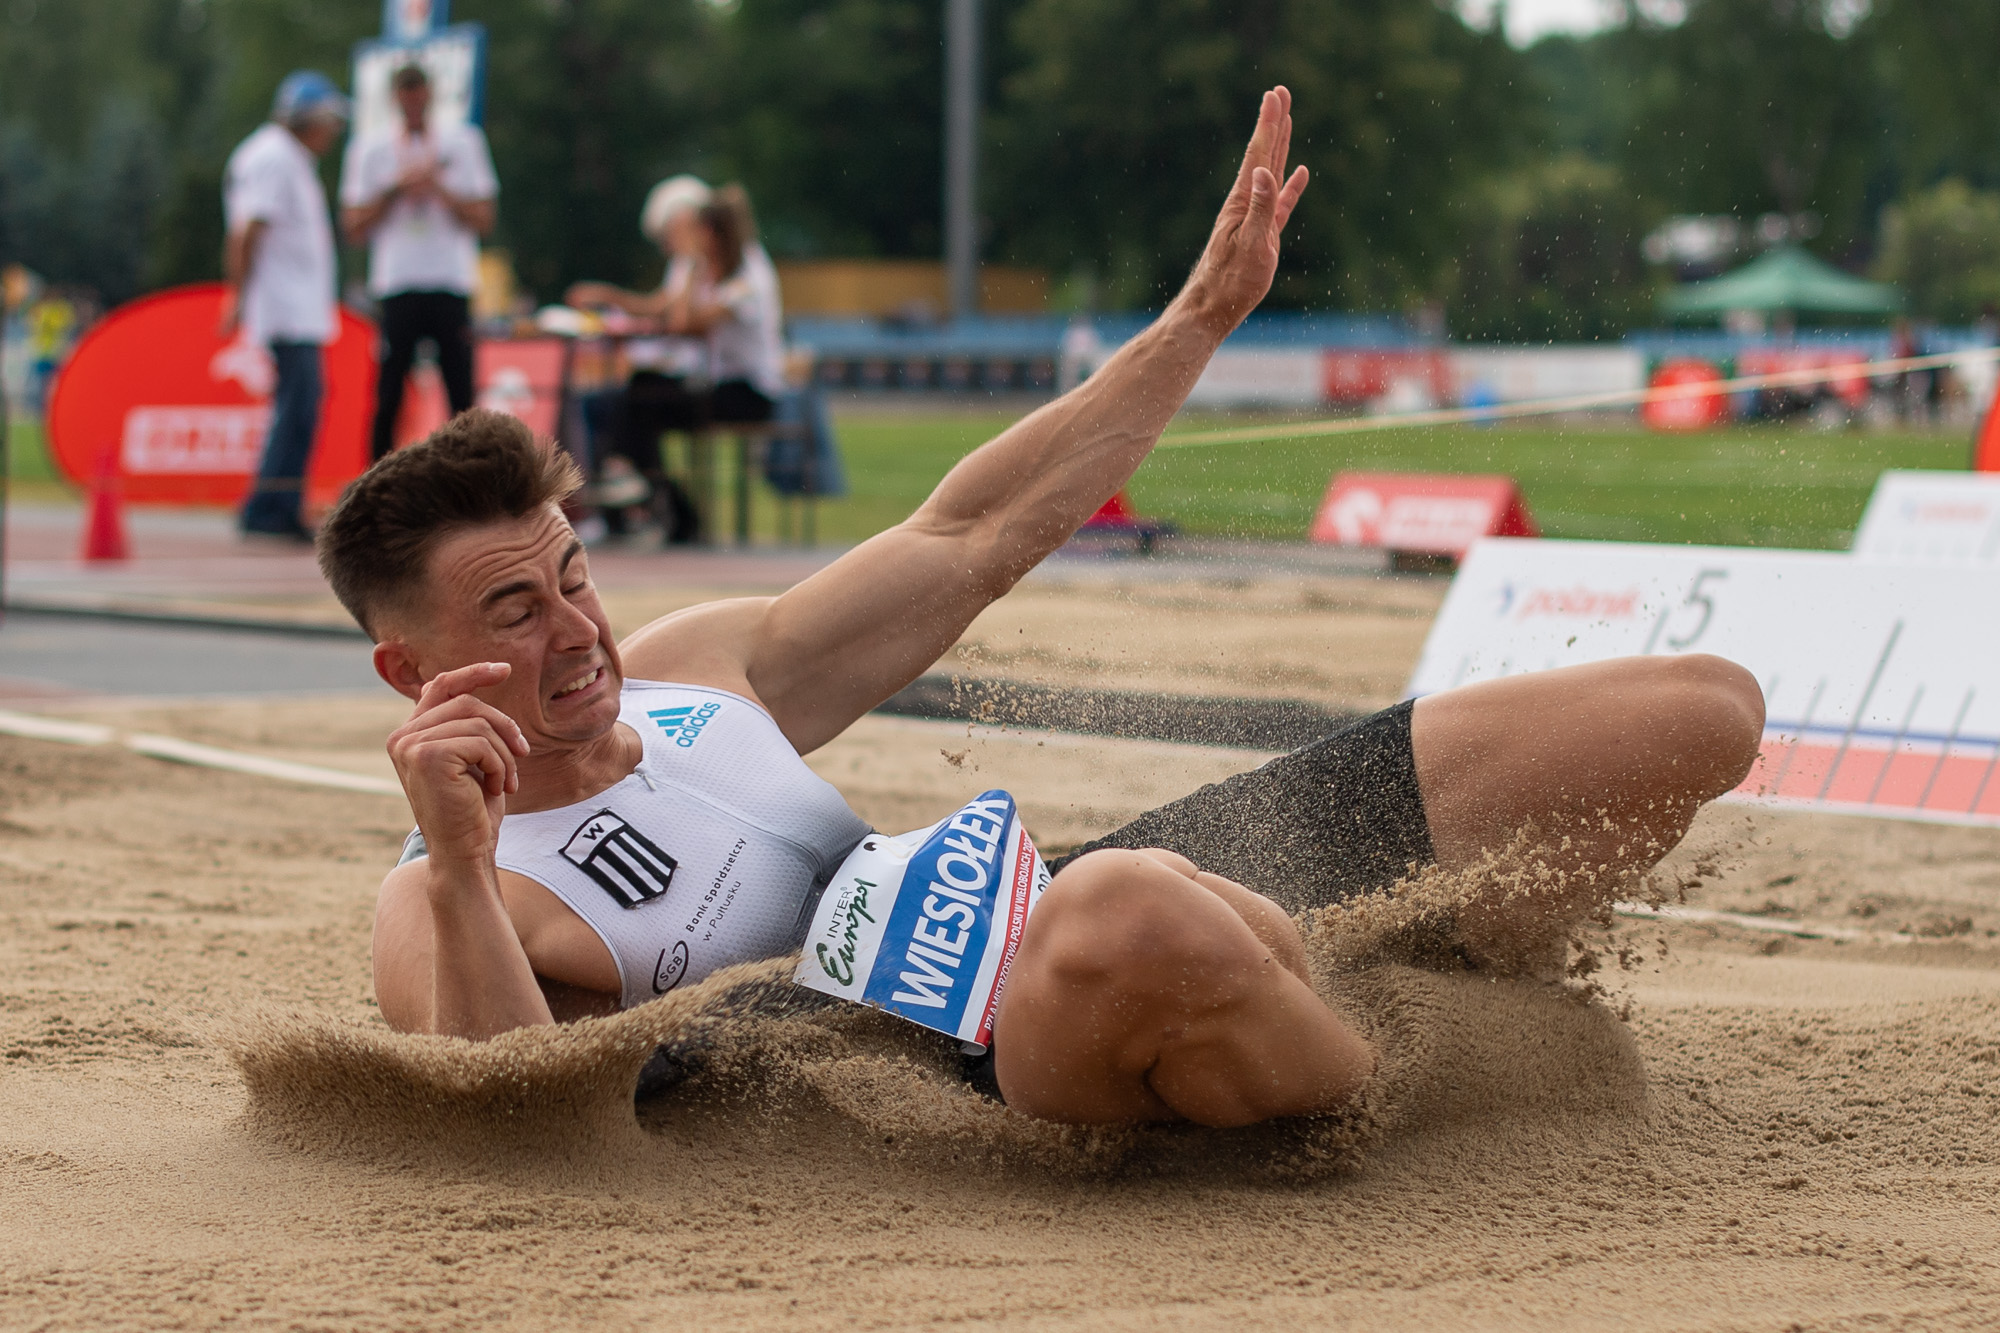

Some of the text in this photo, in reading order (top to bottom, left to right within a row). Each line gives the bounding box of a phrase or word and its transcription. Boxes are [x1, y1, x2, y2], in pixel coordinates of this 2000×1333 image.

[1667, 569, 1728, 648] 5
[676, 702, 721, 748] adidas
[583, 822, 605, 840] W
[686, 838, 746, 932] Bank Spółdzielczy
[1015, 853, 1031, 904] WIELOBOJACH
[827, 890, 853, 938] INTER
[891, 799, 1009, 1009] WIESIOŁEK
[1010, 912, 1024, 941] POLSKI
[703, 931, 712, 941] w
[816, 877, 878, 986] Europol
[659, 954, 683, 982] SGB
[992, 941, 1018, 1008] MISTRZOSTWA
